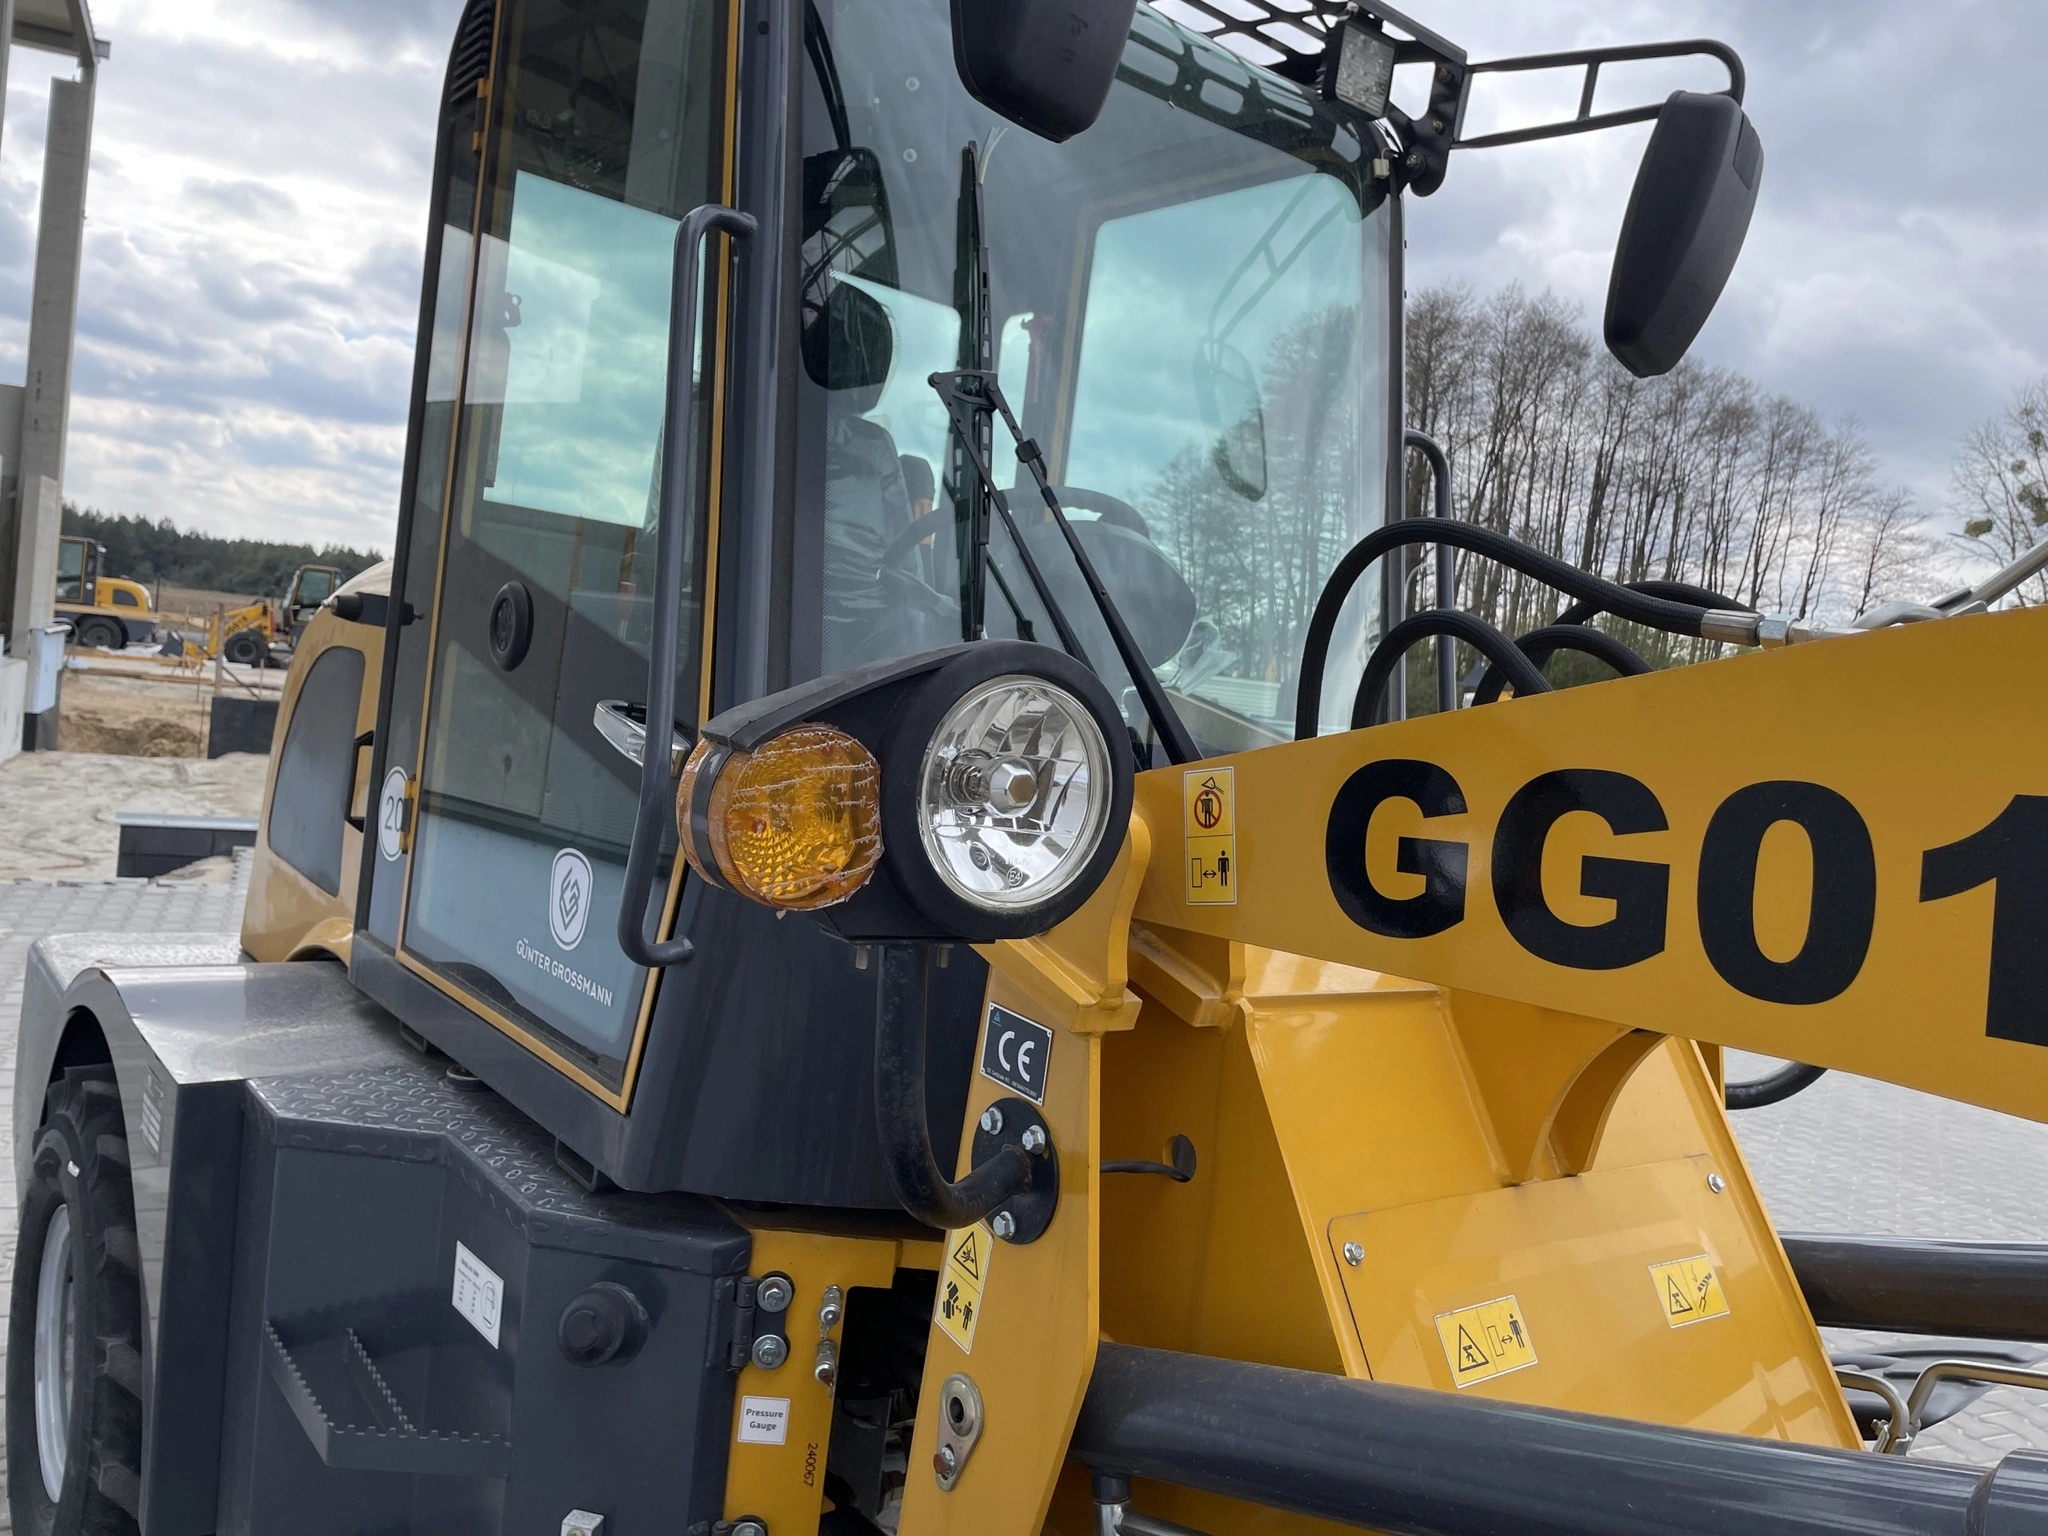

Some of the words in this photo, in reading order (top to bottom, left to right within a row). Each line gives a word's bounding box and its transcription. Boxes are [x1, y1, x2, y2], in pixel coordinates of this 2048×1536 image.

[384, 795, 404, 832] 20
[1325, 758, 2048, 1048] GG01
[516, 937, 550, 973] GÜNTER
[551, 960, 612, 1007] GROSSMANN
[998, 1030, 1035, 1082] CE
[745, 1408, 784, 1418] Pressure
[749, 1421, 777, 1431] Gauge
[803, 1442, 819, 1487] 240067
